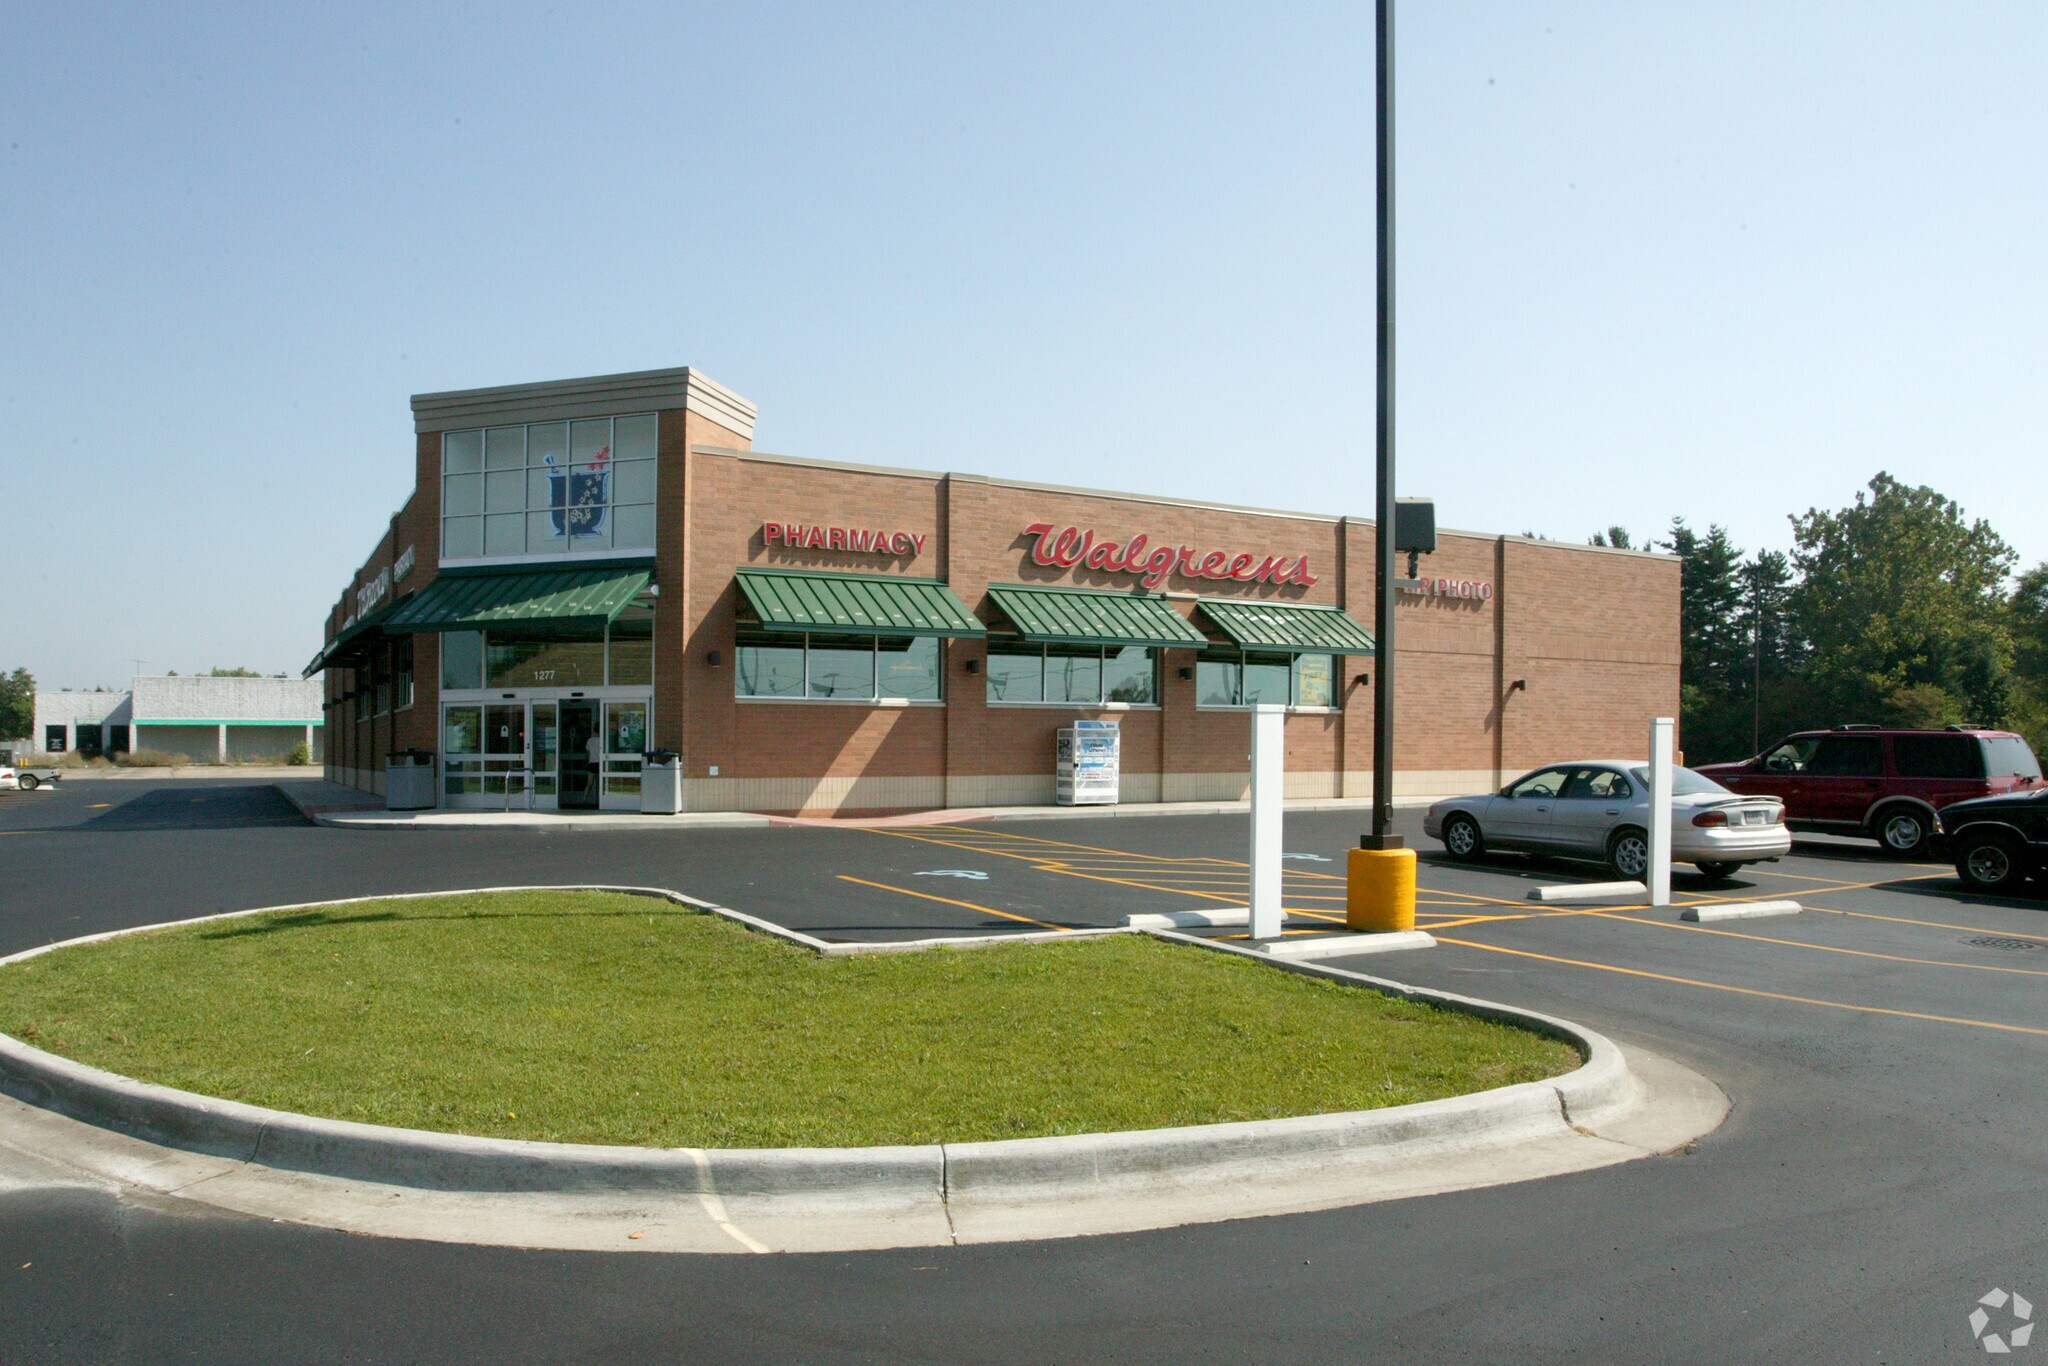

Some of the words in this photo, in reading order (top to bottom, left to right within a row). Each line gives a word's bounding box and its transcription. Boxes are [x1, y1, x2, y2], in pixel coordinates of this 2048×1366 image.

[764, 522, 927, 556] PHARMACY
[1022, 523, 1318, 588] Walgreens
[1434, 578, 1493, 600] PHOTO
[534, 670, 555, 680] 1277
